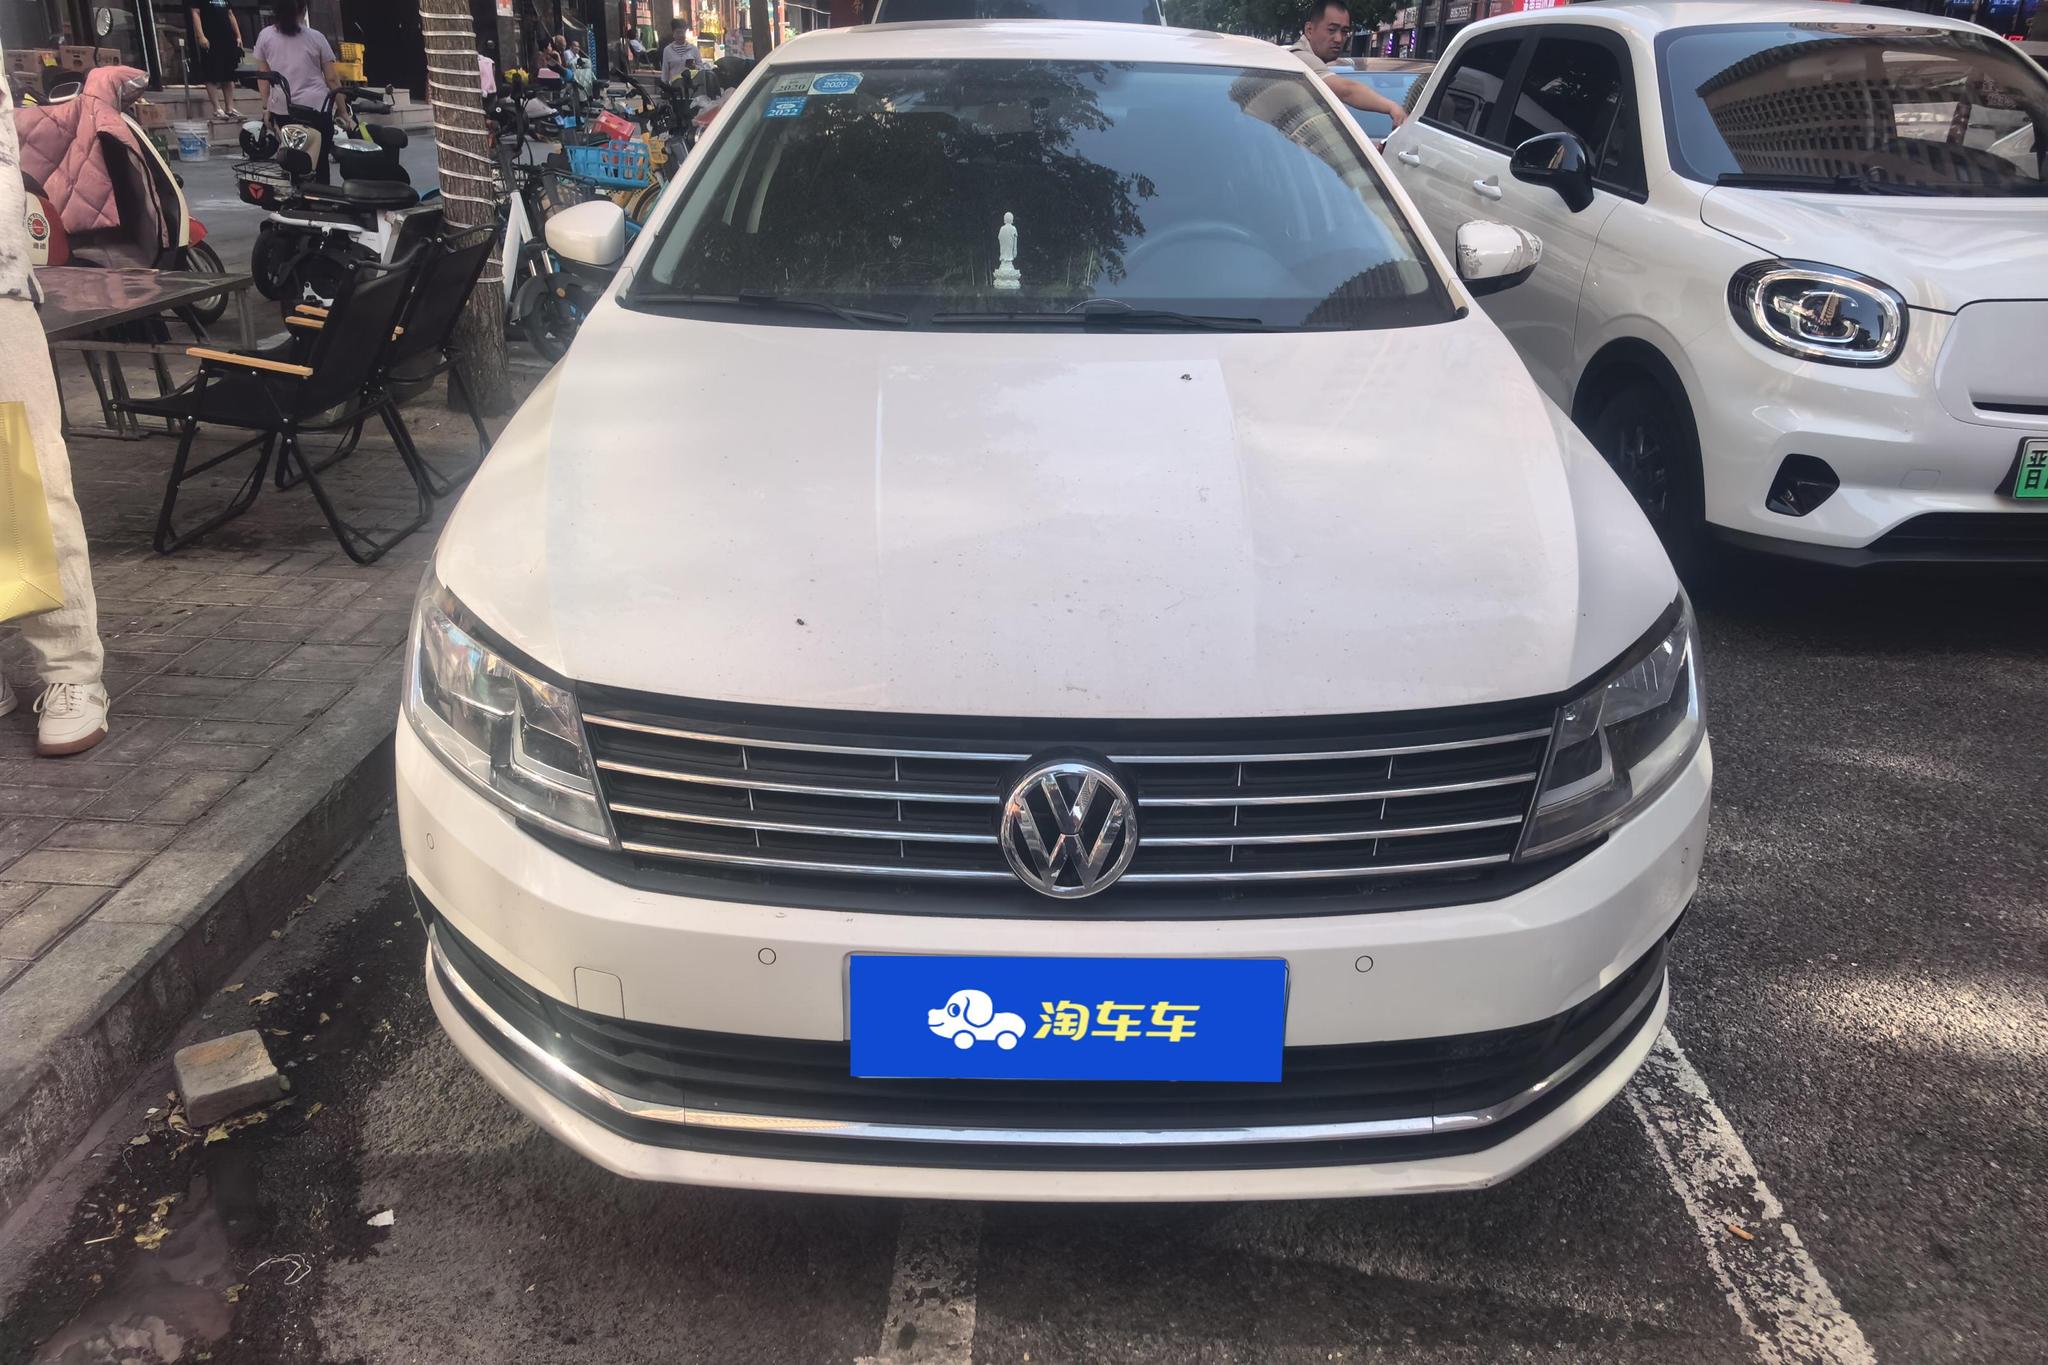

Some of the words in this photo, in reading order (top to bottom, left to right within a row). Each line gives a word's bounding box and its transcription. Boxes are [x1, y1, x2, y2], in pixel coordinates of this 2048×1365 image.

[822, 81, 848, 89] 2020
[767, 108, 799, 117] 2022
[2024, 450, 2048, 489] 晋
